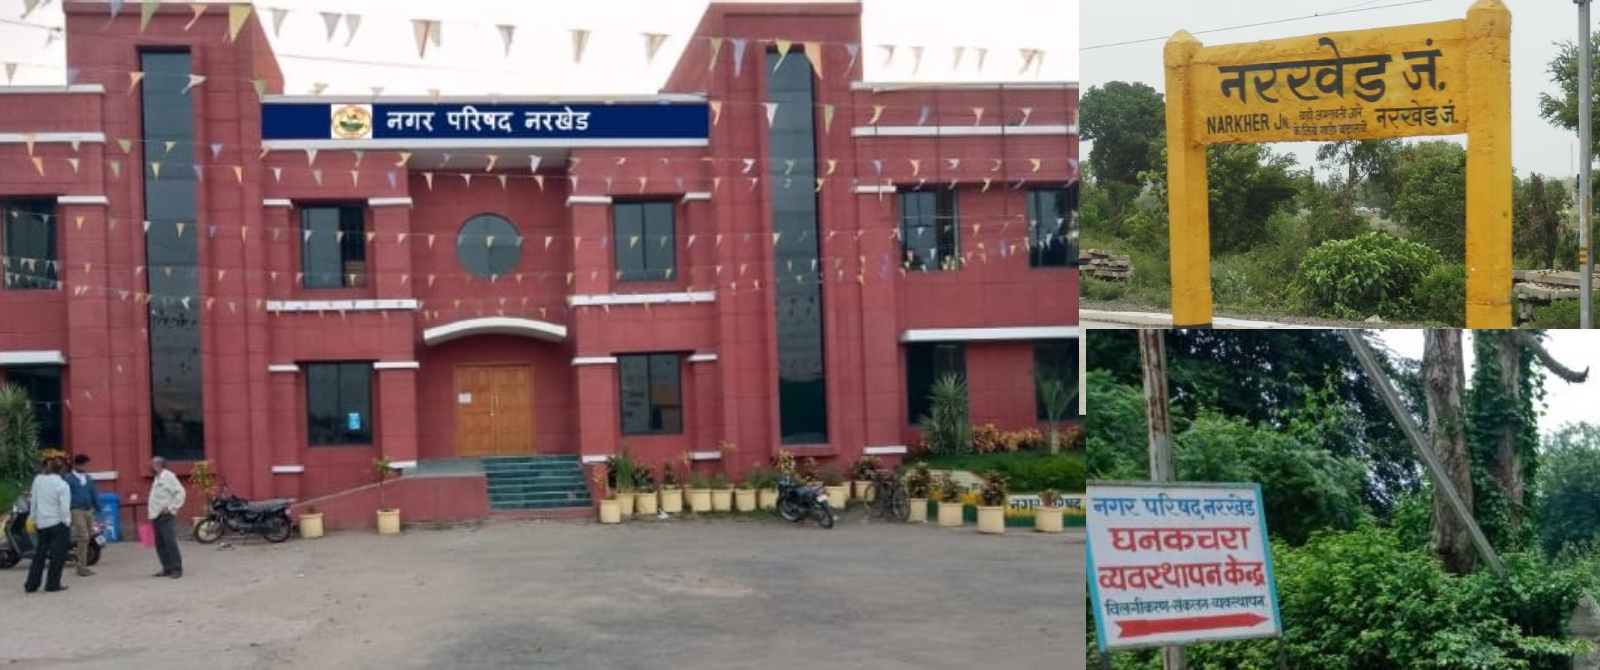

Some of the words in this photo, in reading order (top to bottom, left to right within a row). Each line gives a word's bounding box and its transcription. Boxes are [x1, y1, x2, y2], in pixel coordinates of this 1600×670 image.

[1218, 37, 1393, 104] नरखेड
[387, 111, 436, 132] नगर
[446, 105, 514, 133] परिषद
[525, 106, 590, 131] नरखेड
[1207, 113, 1270, 135] NARKHER
[1373, 99, 1439, 129] नरखेड
[1092, 497, 1140, 516] नगर
[1108, 527, 1251, 552] घनकचरा
[1098, 562, 1222, 591] व्यवस्थापन
[1224, 554, 1266, 586] केन्द्र
